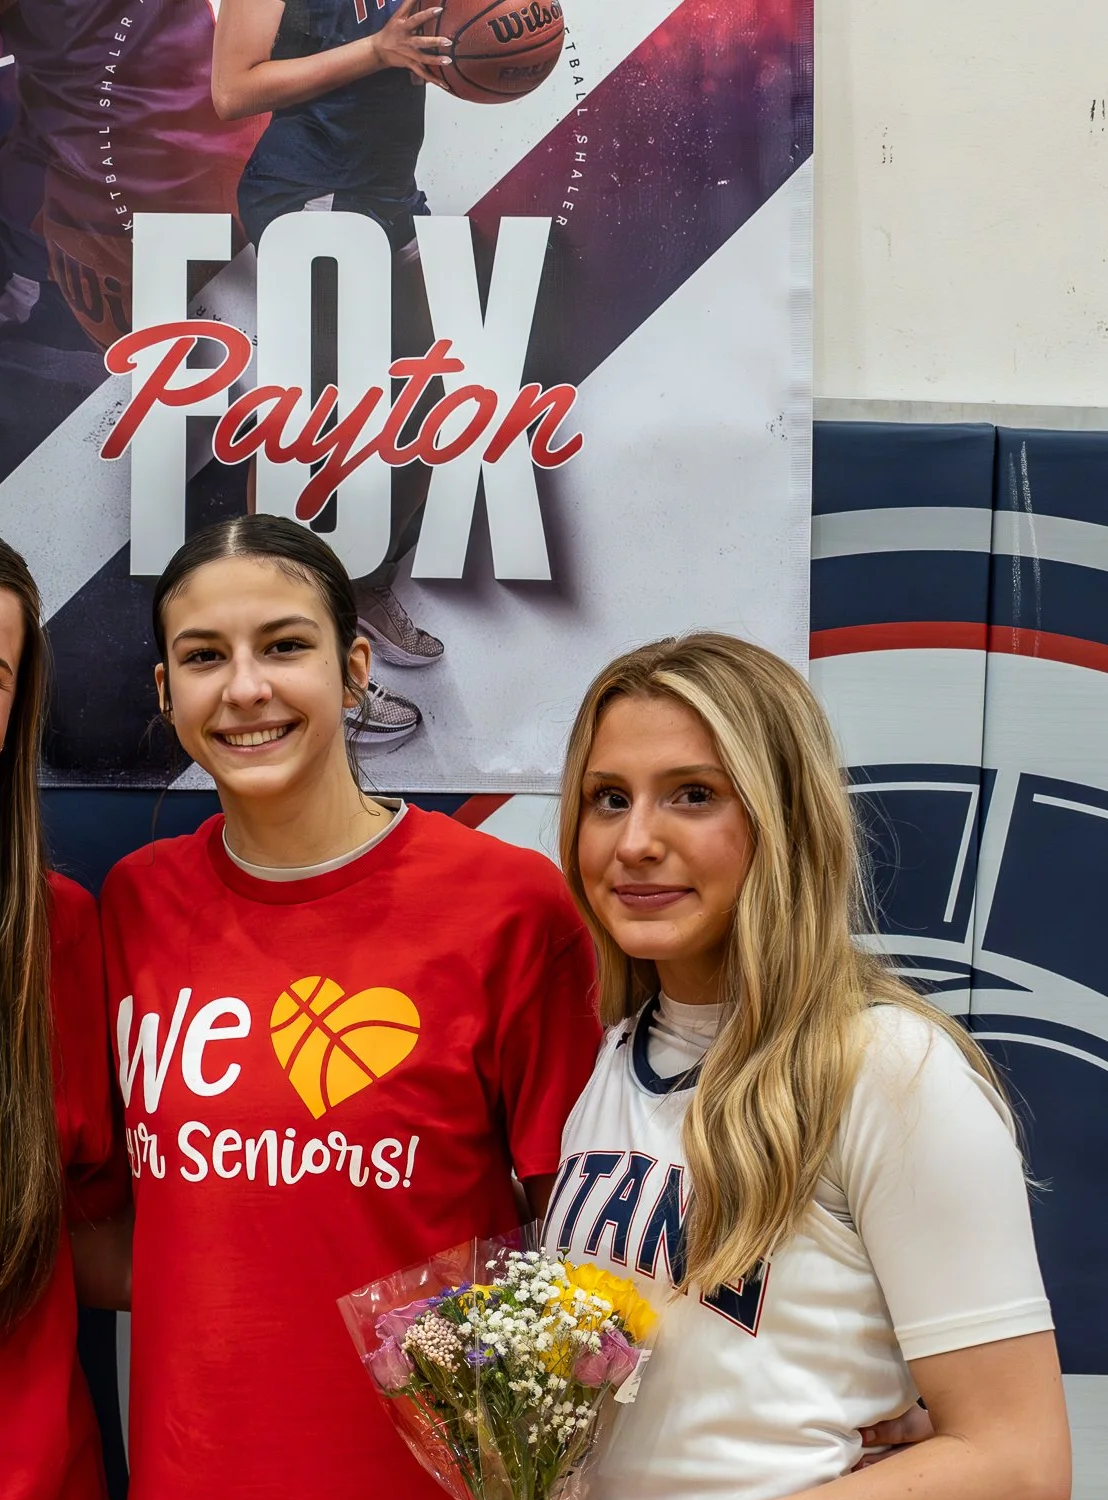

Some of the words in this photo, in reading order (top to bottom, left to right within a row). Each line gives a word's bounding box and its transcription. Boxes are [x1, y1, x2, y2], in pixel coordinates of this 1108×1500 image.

[98, 16, 133, 108] SHALER
[555, 134, 589, 227] SHALER
[99, 319, 584, 522] Payton
[129, 210, 553, 581] FOX
[116, 987, 252, 1115] We
